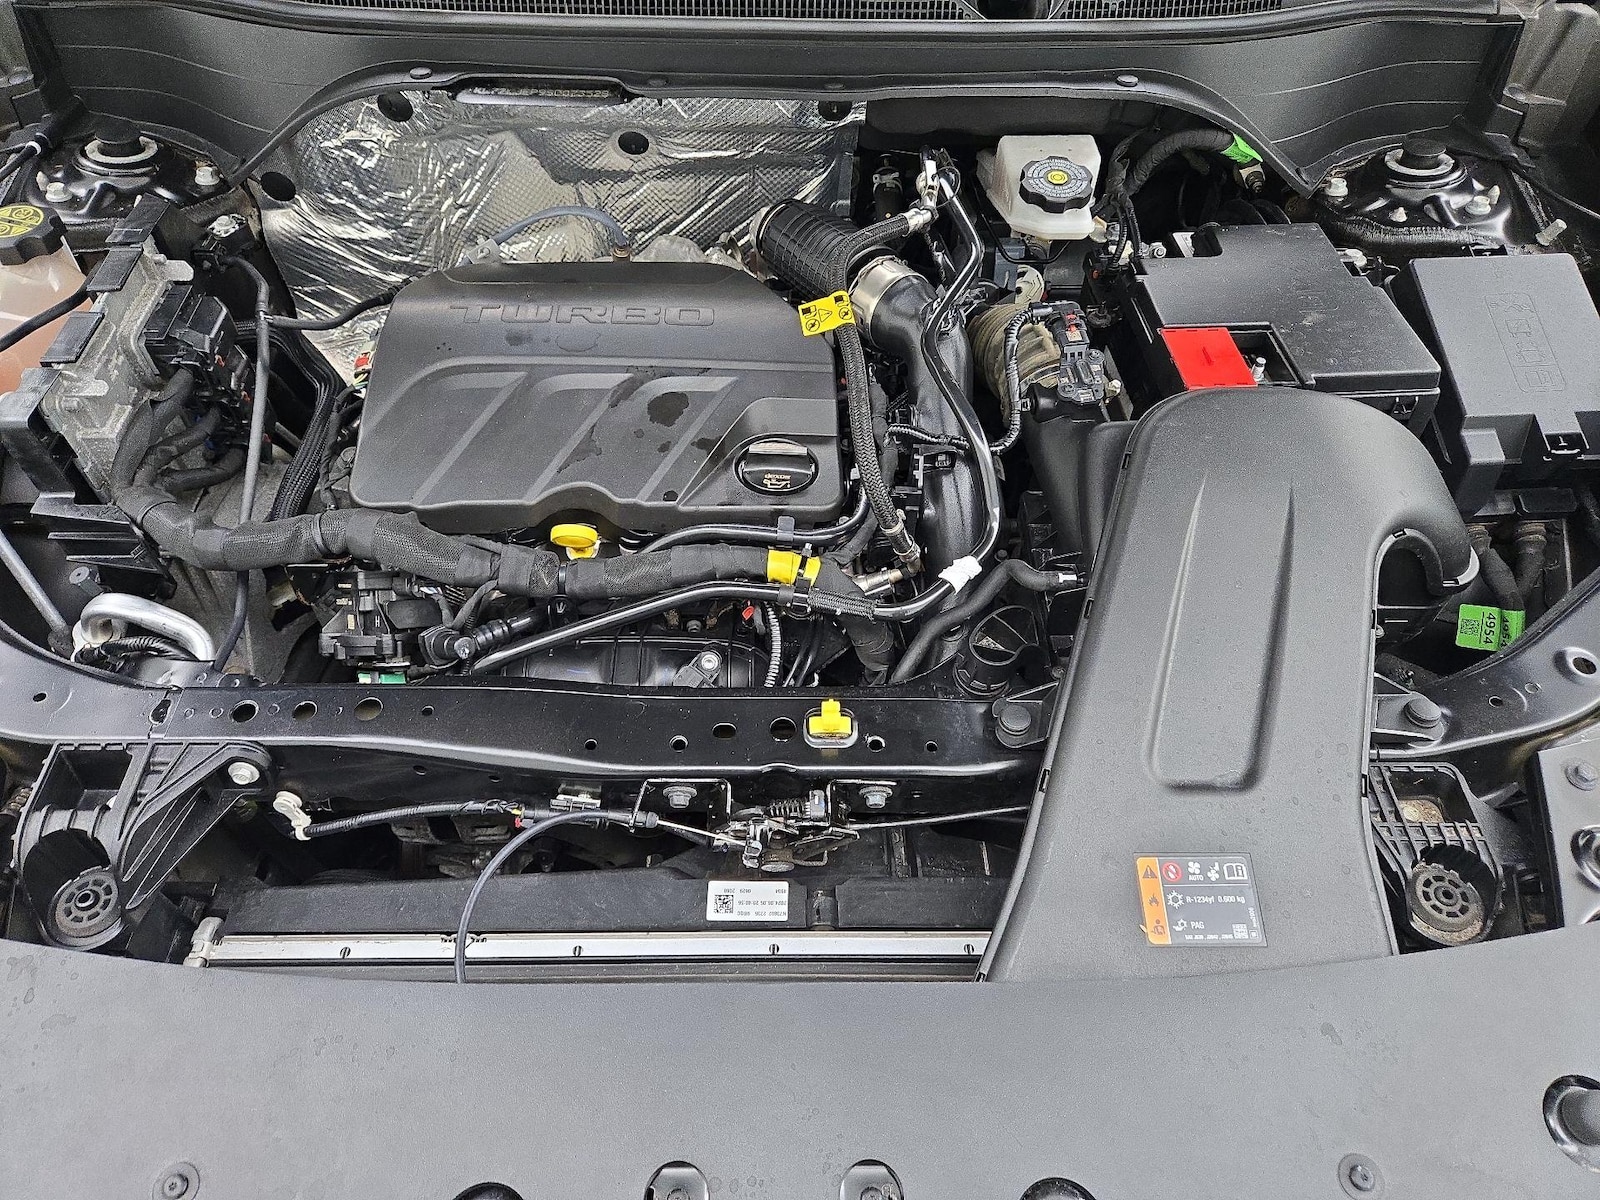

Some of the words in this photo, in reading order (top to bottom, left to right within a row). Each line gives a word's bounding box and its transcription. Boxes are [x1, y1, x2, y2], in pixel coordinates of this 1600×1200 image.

[449, 304, 716, 327] TURBO
[1483, 612, 1497, 645] 4954
[1236, 895, 1245, 904] kg
